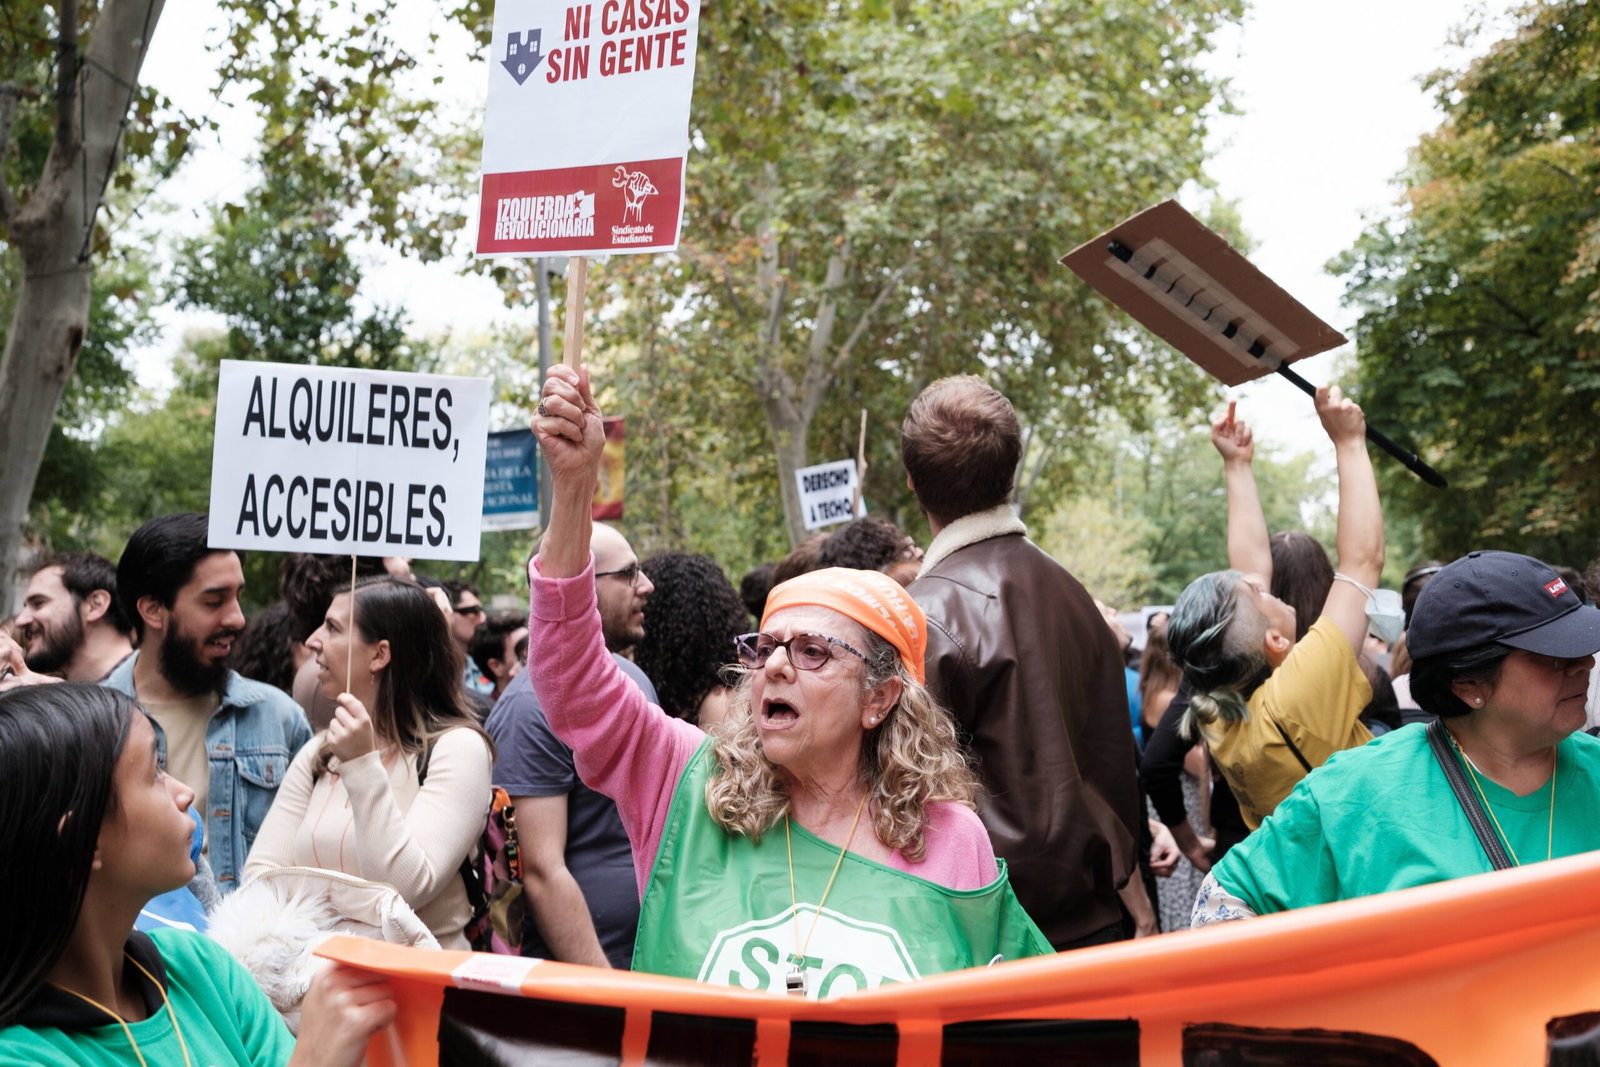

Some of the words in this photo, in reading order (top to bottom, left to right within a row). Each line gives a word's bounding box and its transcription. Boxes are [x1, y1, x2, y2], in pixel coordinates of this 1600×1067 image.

[564, 4, 592, 41] NI
[601, 0, 690, 35] CASAS
[546, 44, 590, 84] SIN
[599, 29, 687, 77] GENTE
[496, 194, 575, 222] IZQUIERDA
[494, 217, 595, 240] REVOLUCIONARIA
[611, 224, 645, 235] Sindicato
[645, 223, 655, 233] de
[611, 234, 653, 245] Estudiantes
[242, 375, 460, 463] ALQUILERES,
[803, 467, 849, 493] DERECHO
[236, 473, 454, 547] ACCESIBLES.
[728, 937, 904, 1002] STO
